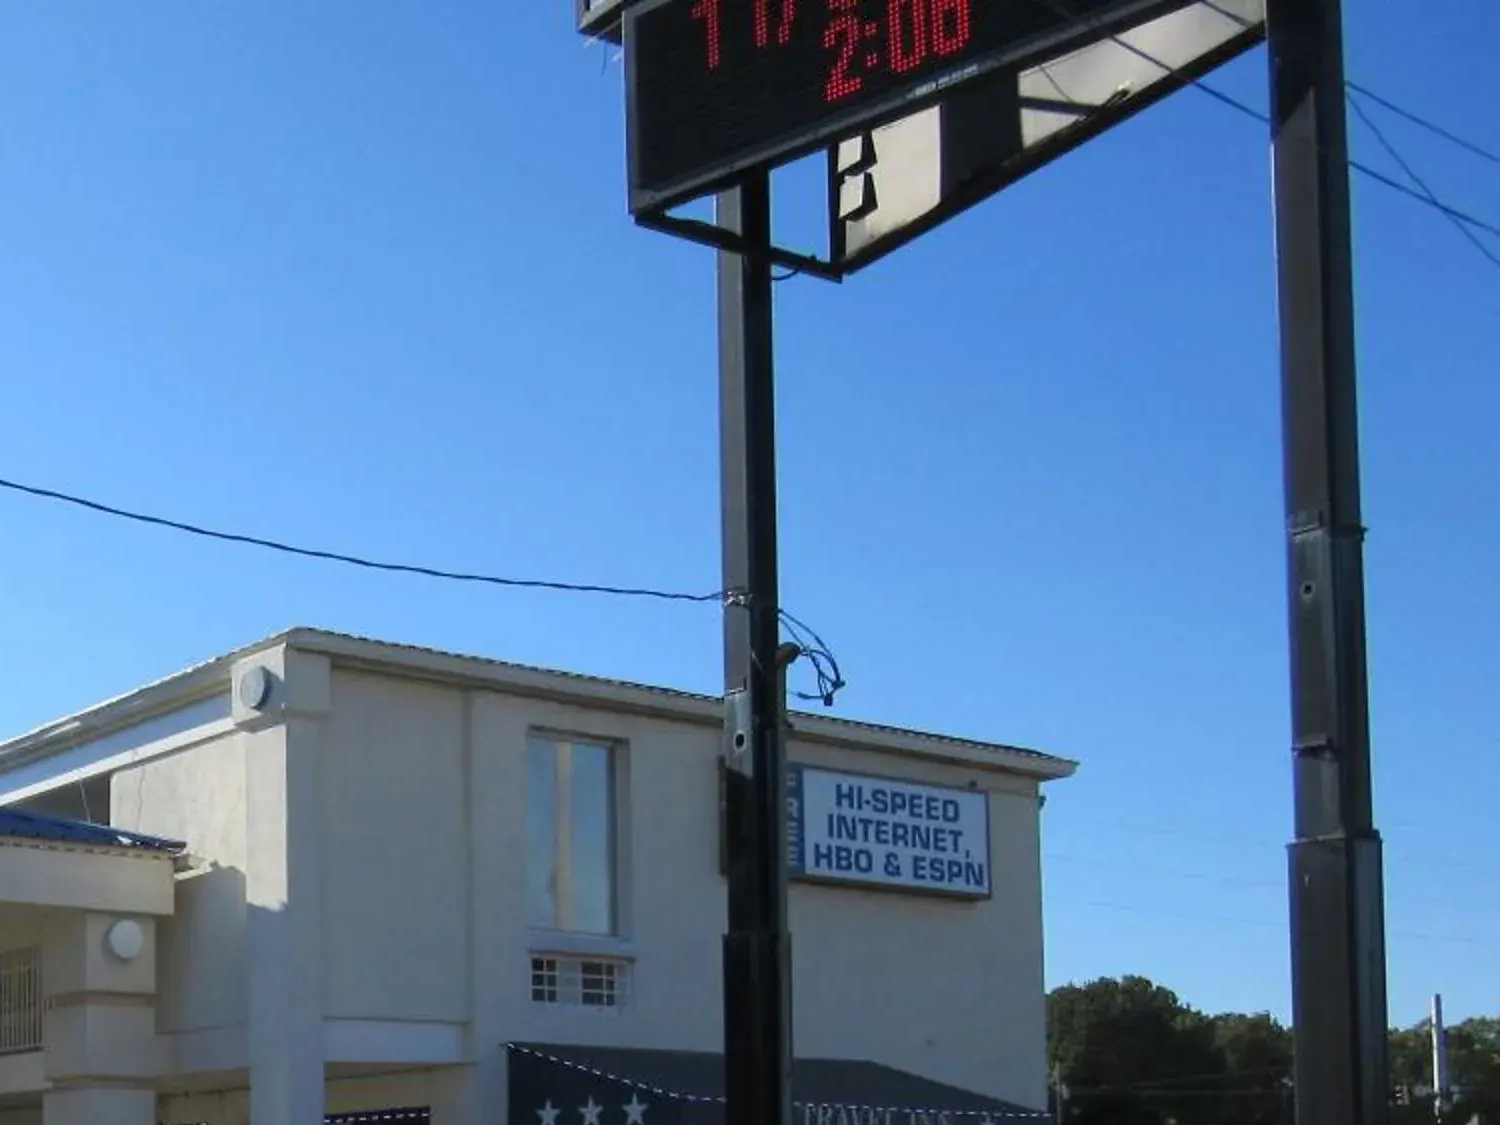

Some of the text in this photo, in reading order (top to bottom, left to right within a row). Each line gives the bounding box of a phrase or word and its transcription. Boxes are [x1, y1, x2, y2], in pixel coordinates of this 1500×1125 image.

[835, 783, 960, 822] HI-SPEED
[827, 813, 970, 859] INTERNET,
[814, 843, 985, 887] HBO & ESPN
